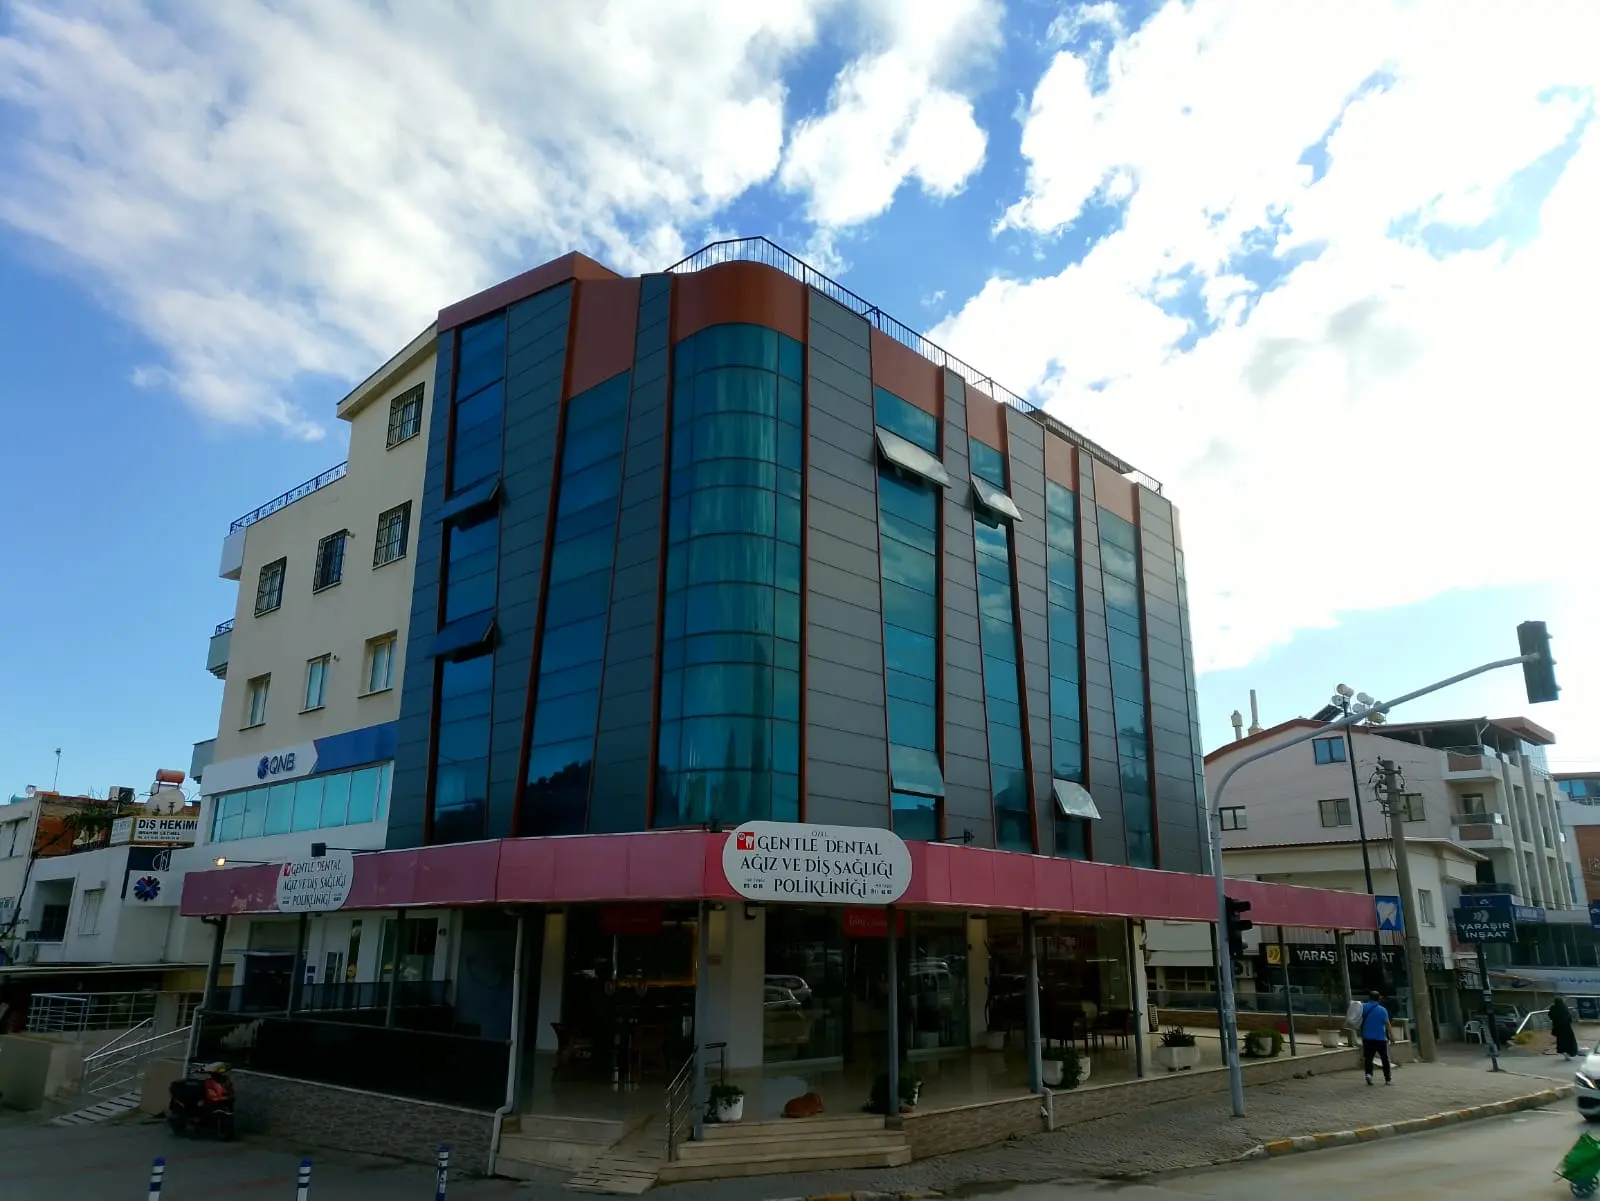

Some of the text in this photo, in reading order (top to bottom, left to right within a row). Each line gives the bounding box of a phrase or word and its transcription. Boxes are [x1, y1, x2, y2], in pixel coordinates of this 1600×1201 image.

[269, 752, 295, 775] QNB
[757, 835, 882, 856] GENTLE DENTAL
[291, 862, 314, 877] GENTLE
[741, 854, 893, 880] AĞIZ VE DİŞ SAĞLIĞI
[773, 876, 867, 899] POLİKLİNİĞİ
[1459, 922, 1510, 932] YARAŞIR
[1296, 949, 1338, 966] YARAŞI
